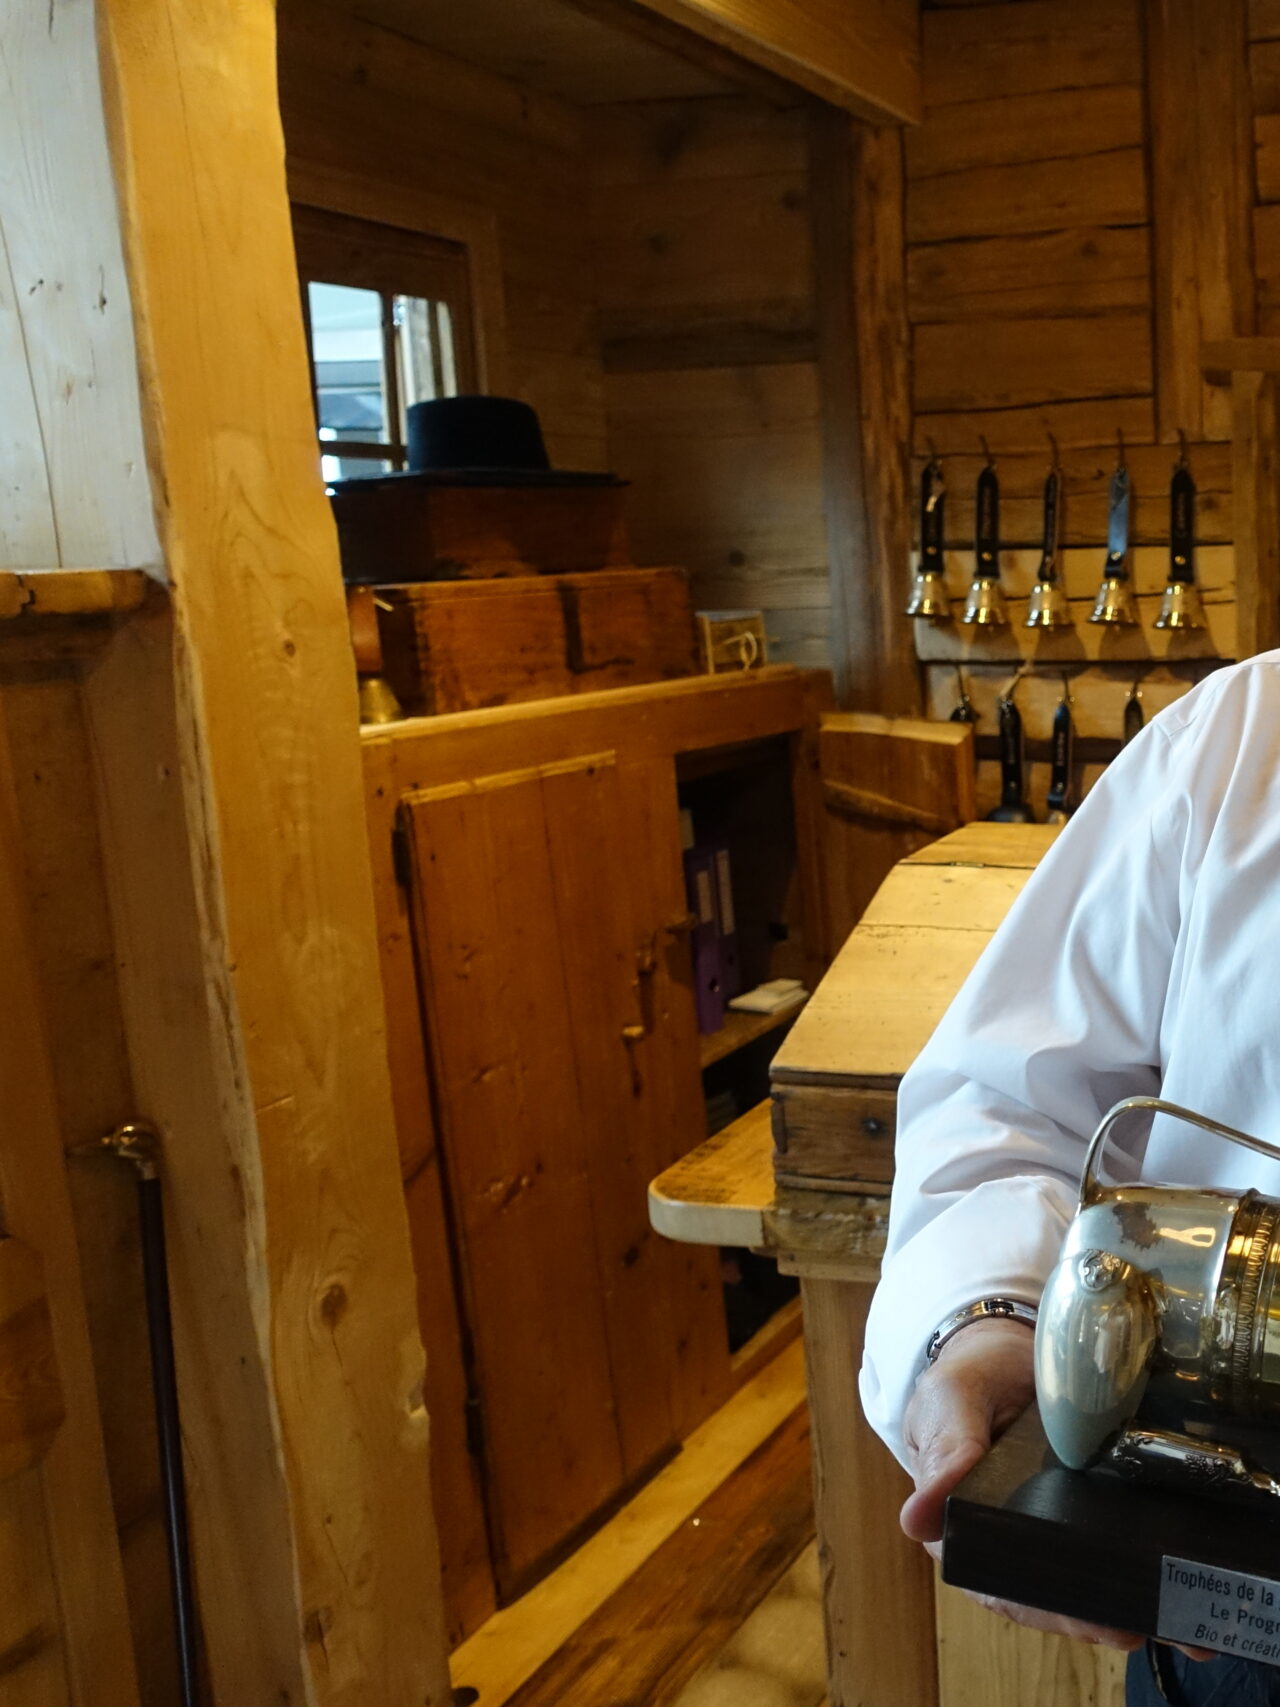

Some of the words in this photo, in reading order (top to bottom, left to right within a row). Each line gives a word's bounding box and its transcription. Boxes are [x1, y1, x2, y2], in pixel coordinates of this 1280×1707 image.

[1167, 1564, 1231, 1595] Trophées
[1237, 1581, 1255, 1601] de
[1261, 1586, 1274, 1607] la
[1210, 1603, 1229, 1621] Le
[1194, 1623, 1218, 1643] Bio
[1222, 1631, 1238, 1648] et
